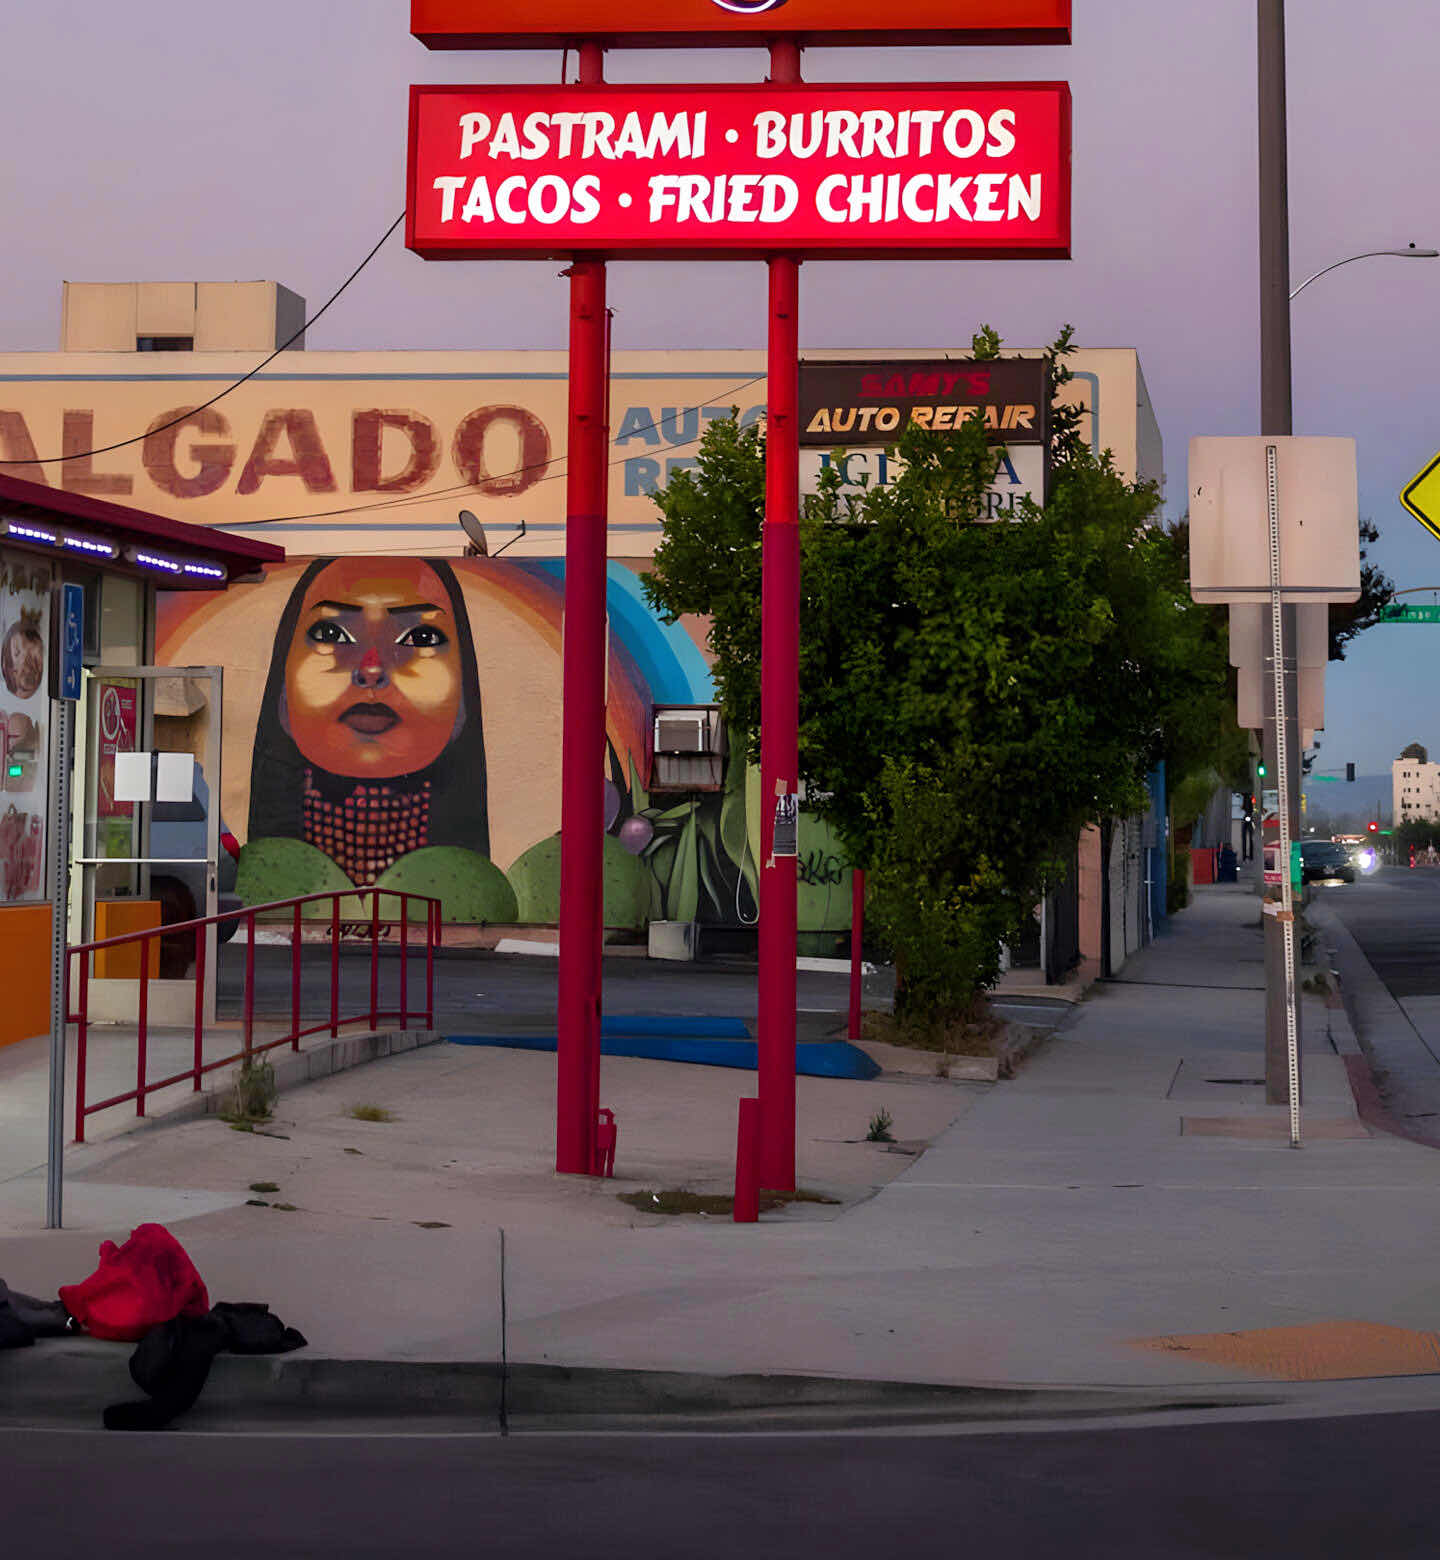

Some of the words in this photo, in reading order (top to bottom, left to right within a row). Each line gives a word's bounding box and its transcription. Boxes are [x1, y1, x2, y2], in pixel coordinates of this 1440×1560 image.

[458, 110, 707, 161] PASTRAMI
[752, 108, 1017, 160] BURRITOS
[432, 175, 602, 225] TACOS
[647, 174, 800, 225] FRIED
[814, 173, 1043, 224] CHICKEN
[805, 406, 901, 433] AUTO
[905, 403, 1037, 431] REPAIR
